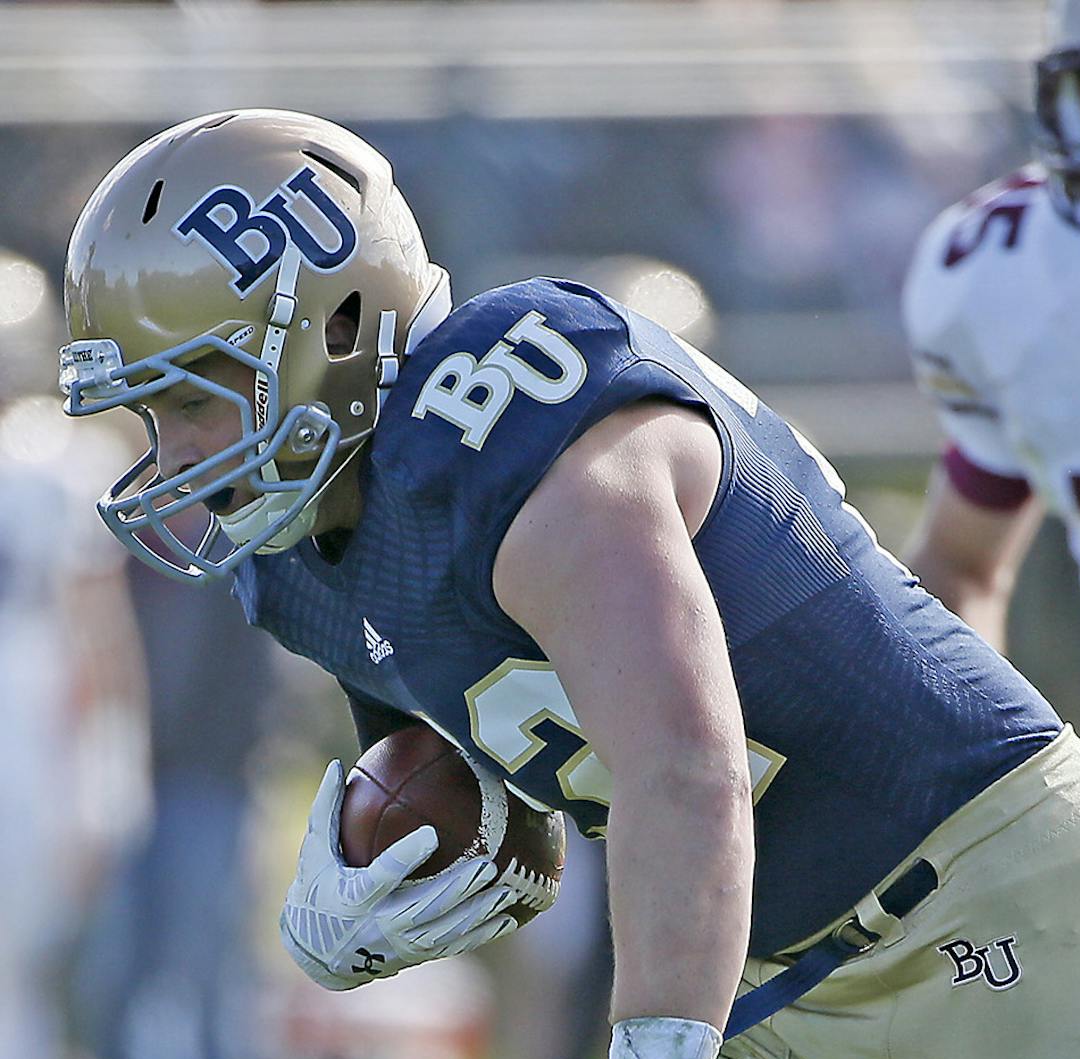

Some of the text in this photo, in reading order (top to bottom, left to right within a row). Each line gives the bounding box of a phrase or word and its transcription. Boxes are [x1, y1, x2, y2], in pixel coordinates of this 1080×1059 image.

[170, 164, 359, 300] BU
[411, 309, 588, 452] BU
[936, 935, 1022, 991] BU
